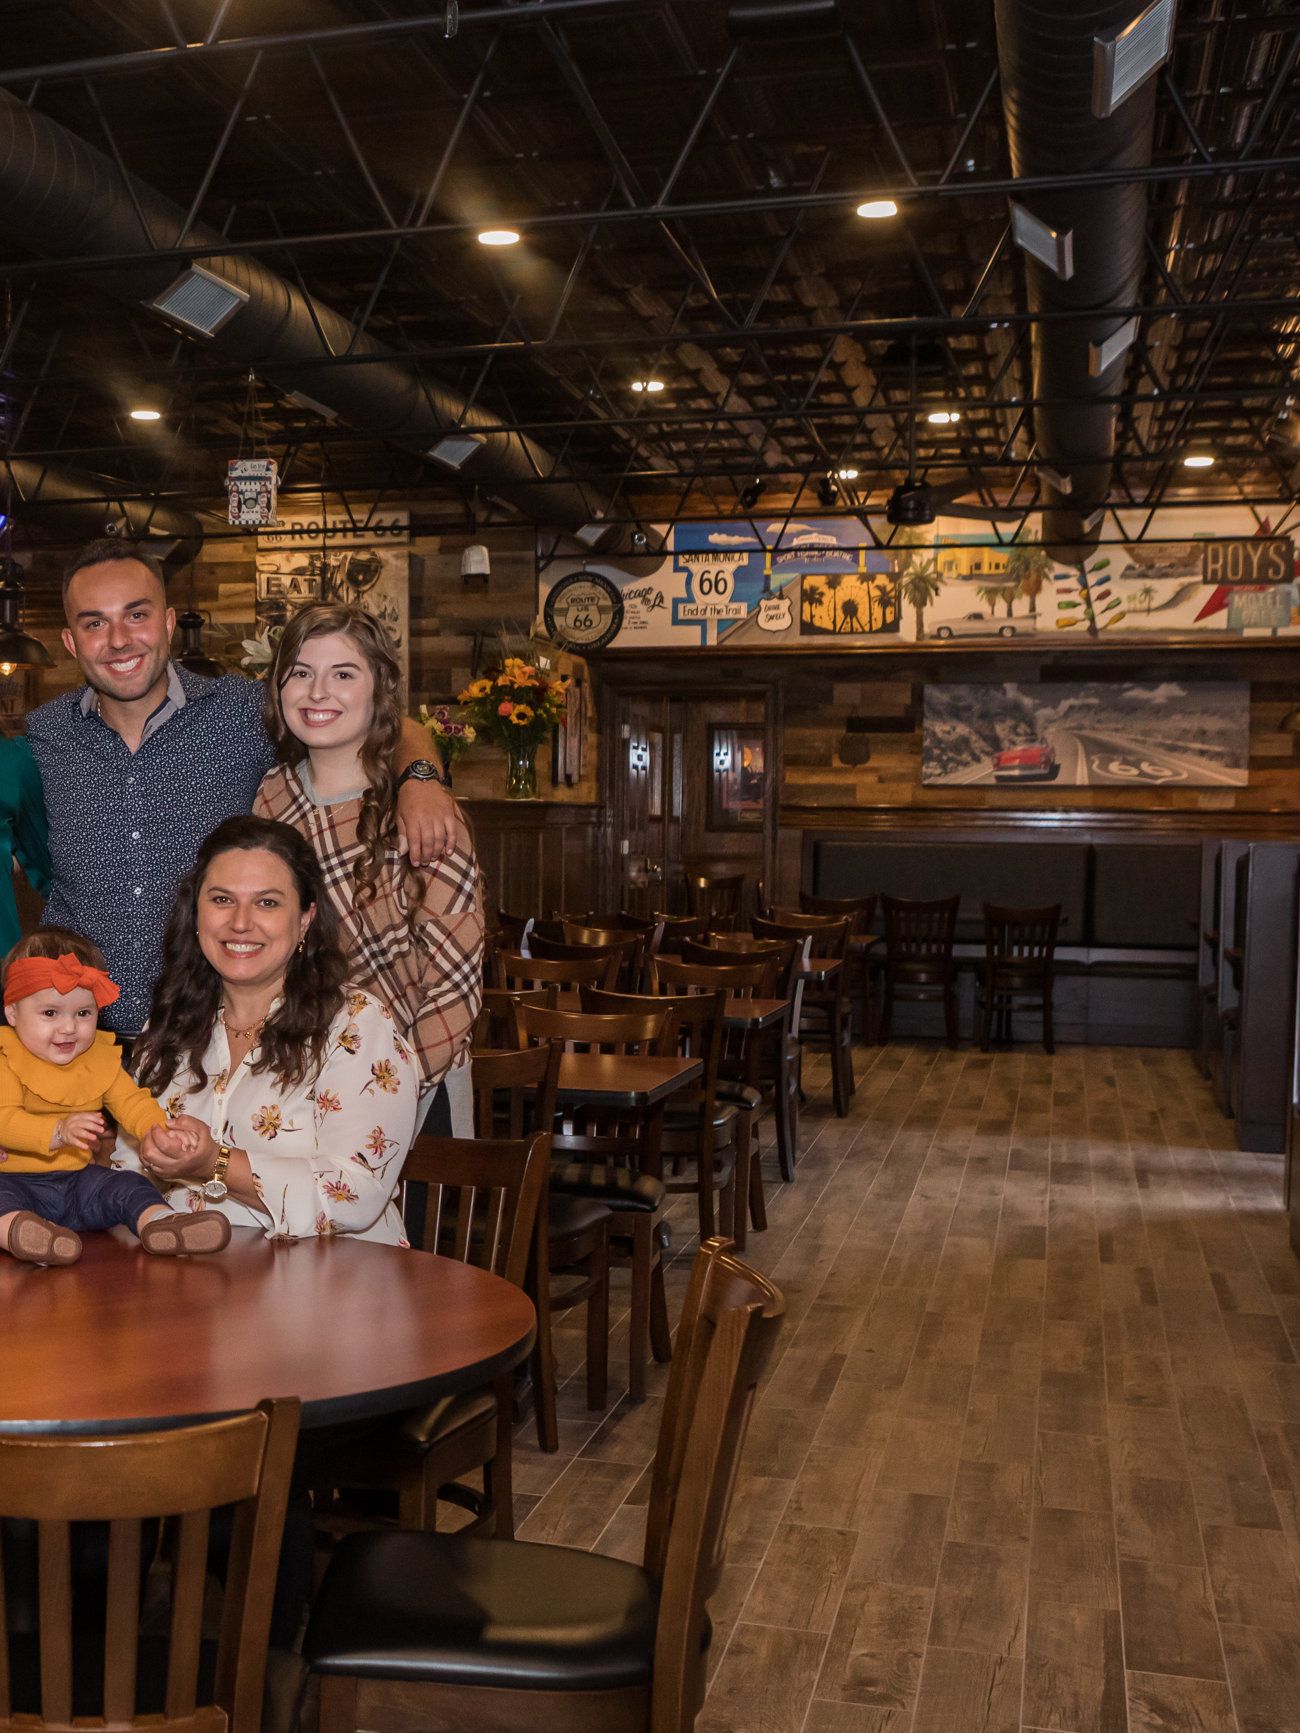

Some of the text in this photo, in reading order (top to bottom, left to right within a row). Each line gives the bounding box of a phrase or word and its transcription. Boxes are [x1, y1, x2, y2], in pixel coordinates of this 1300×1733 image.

[291, 519, 366, 540] ROUTE
[682, 552, 745, 563] SANTA MONICA
[1207, 542, 1287, 582] ROY'S
[266, 576, 318, 595] EAT
[699, 569, 728, 596] 66
[570, 596, 596, 604] ROUTE
[620, 586, 654, 602] hicago
[1233, 592, 1285, 609] MOTEL
[682, 604, 742, 617] End of the Trail
[573, 613, 593, 629] 66
[1108, 760, 1173, 777] 66
